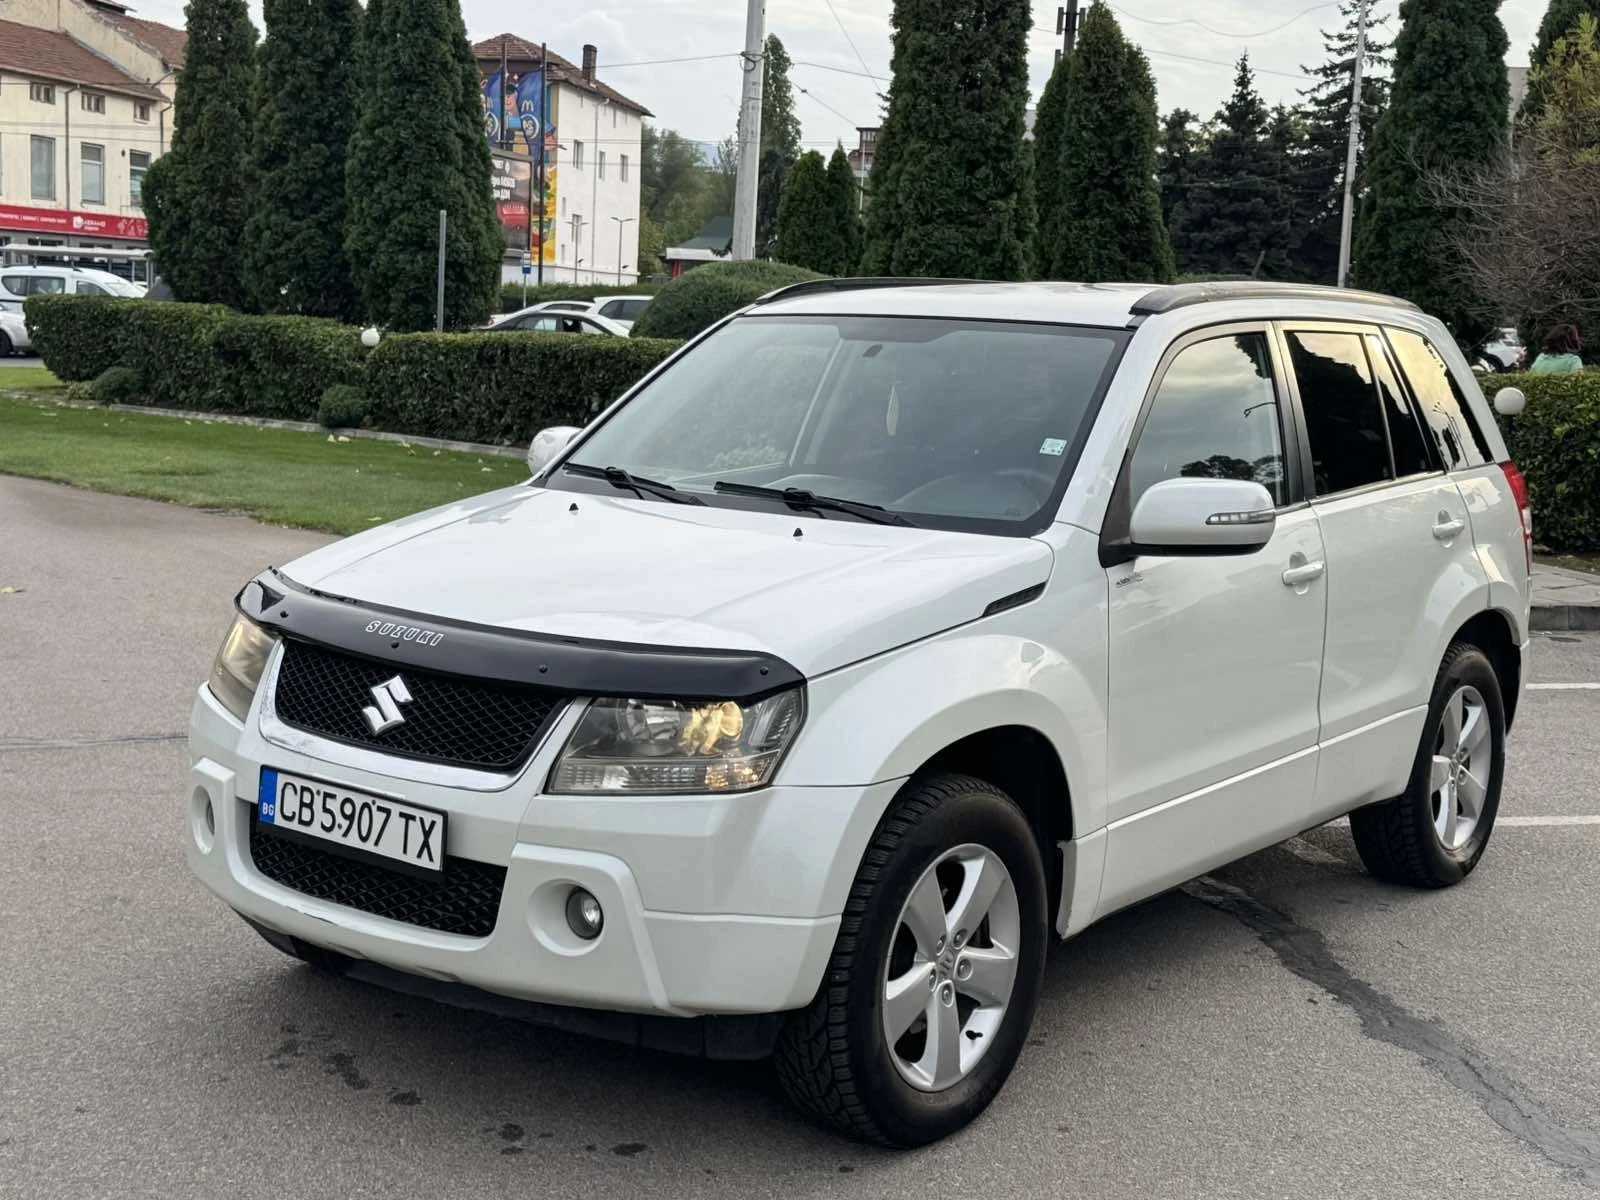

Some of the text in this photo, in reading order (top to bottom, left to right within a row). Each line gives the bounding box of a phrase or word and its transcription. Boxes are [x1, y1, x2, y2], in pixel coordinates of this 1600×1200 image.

[365, 620, 444, 646] SUZUKI
[262, 802, 275, 816] BG
[398, 811, 437, 862] TX
